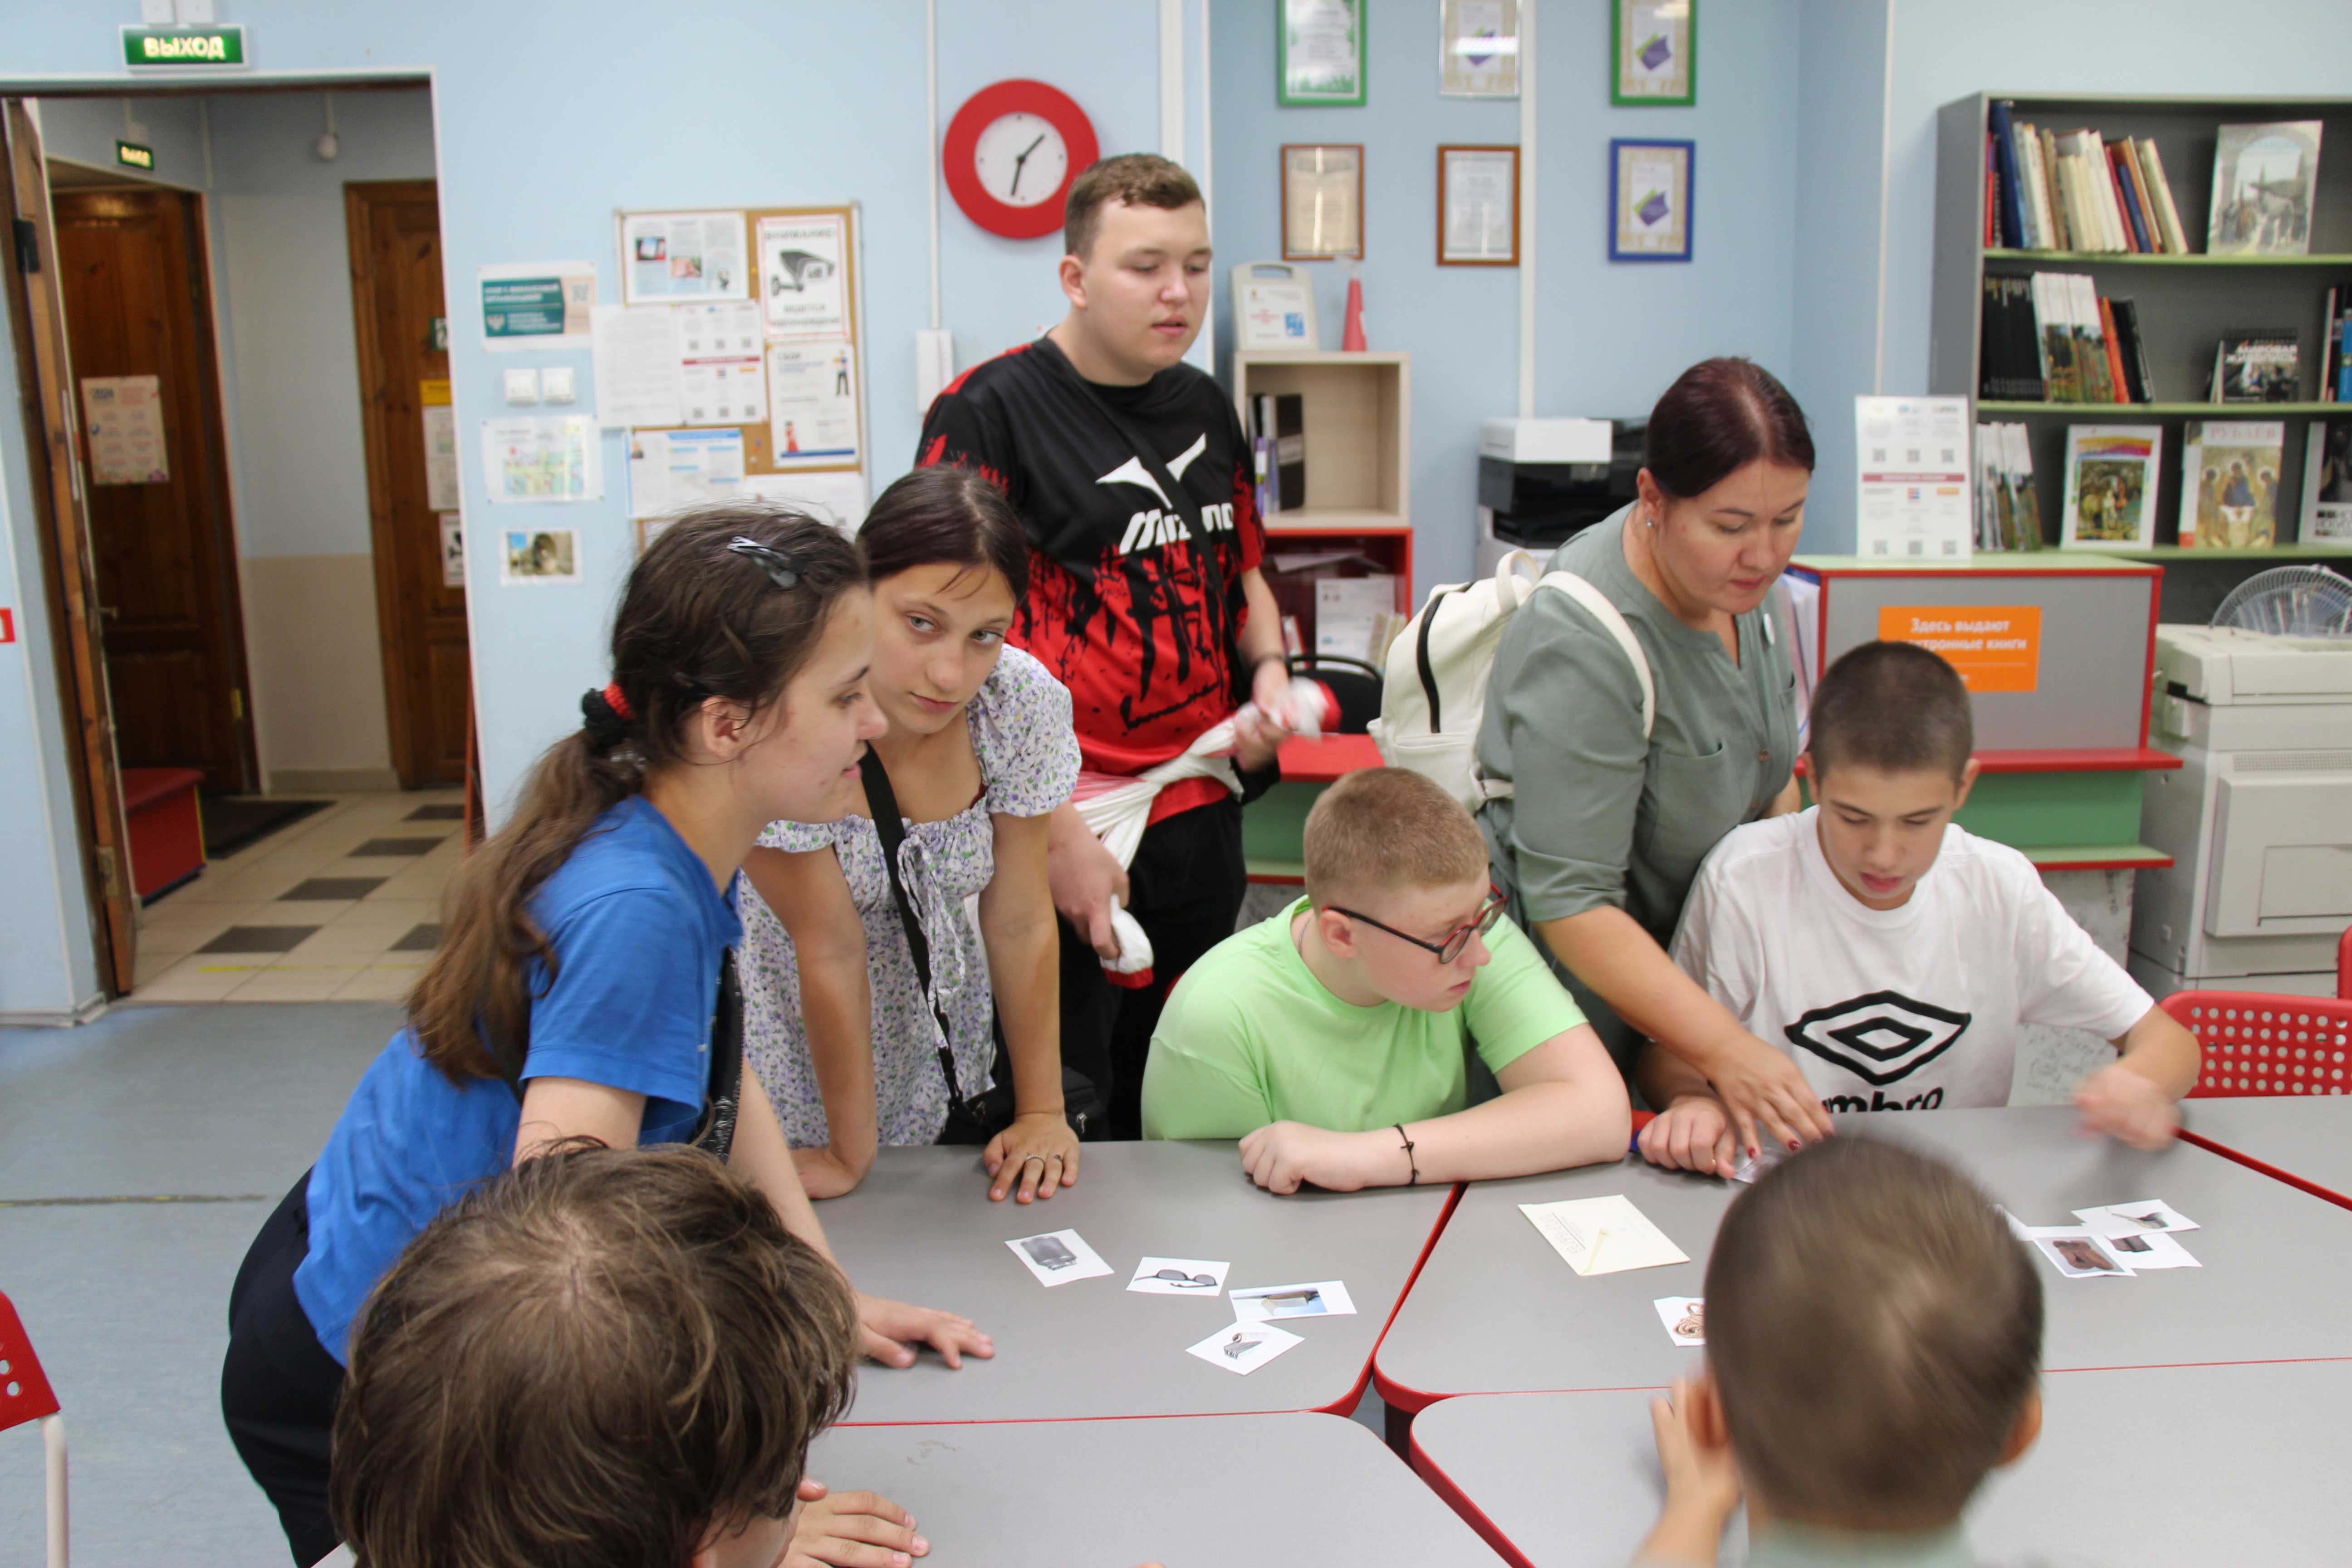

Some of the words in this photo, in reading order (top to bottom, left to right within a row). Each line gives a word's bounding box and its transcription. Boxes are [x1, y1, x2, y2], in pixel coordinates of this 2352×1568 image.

[143, 36, 225, 59] ВЫХОД
[1911, 618, 1952, 632] Здесь
[1955, 621, 2010, 633] выдают
[1986, 639, 2028, 650] книги
[1822, 1087, 1944, 1113] mbro
